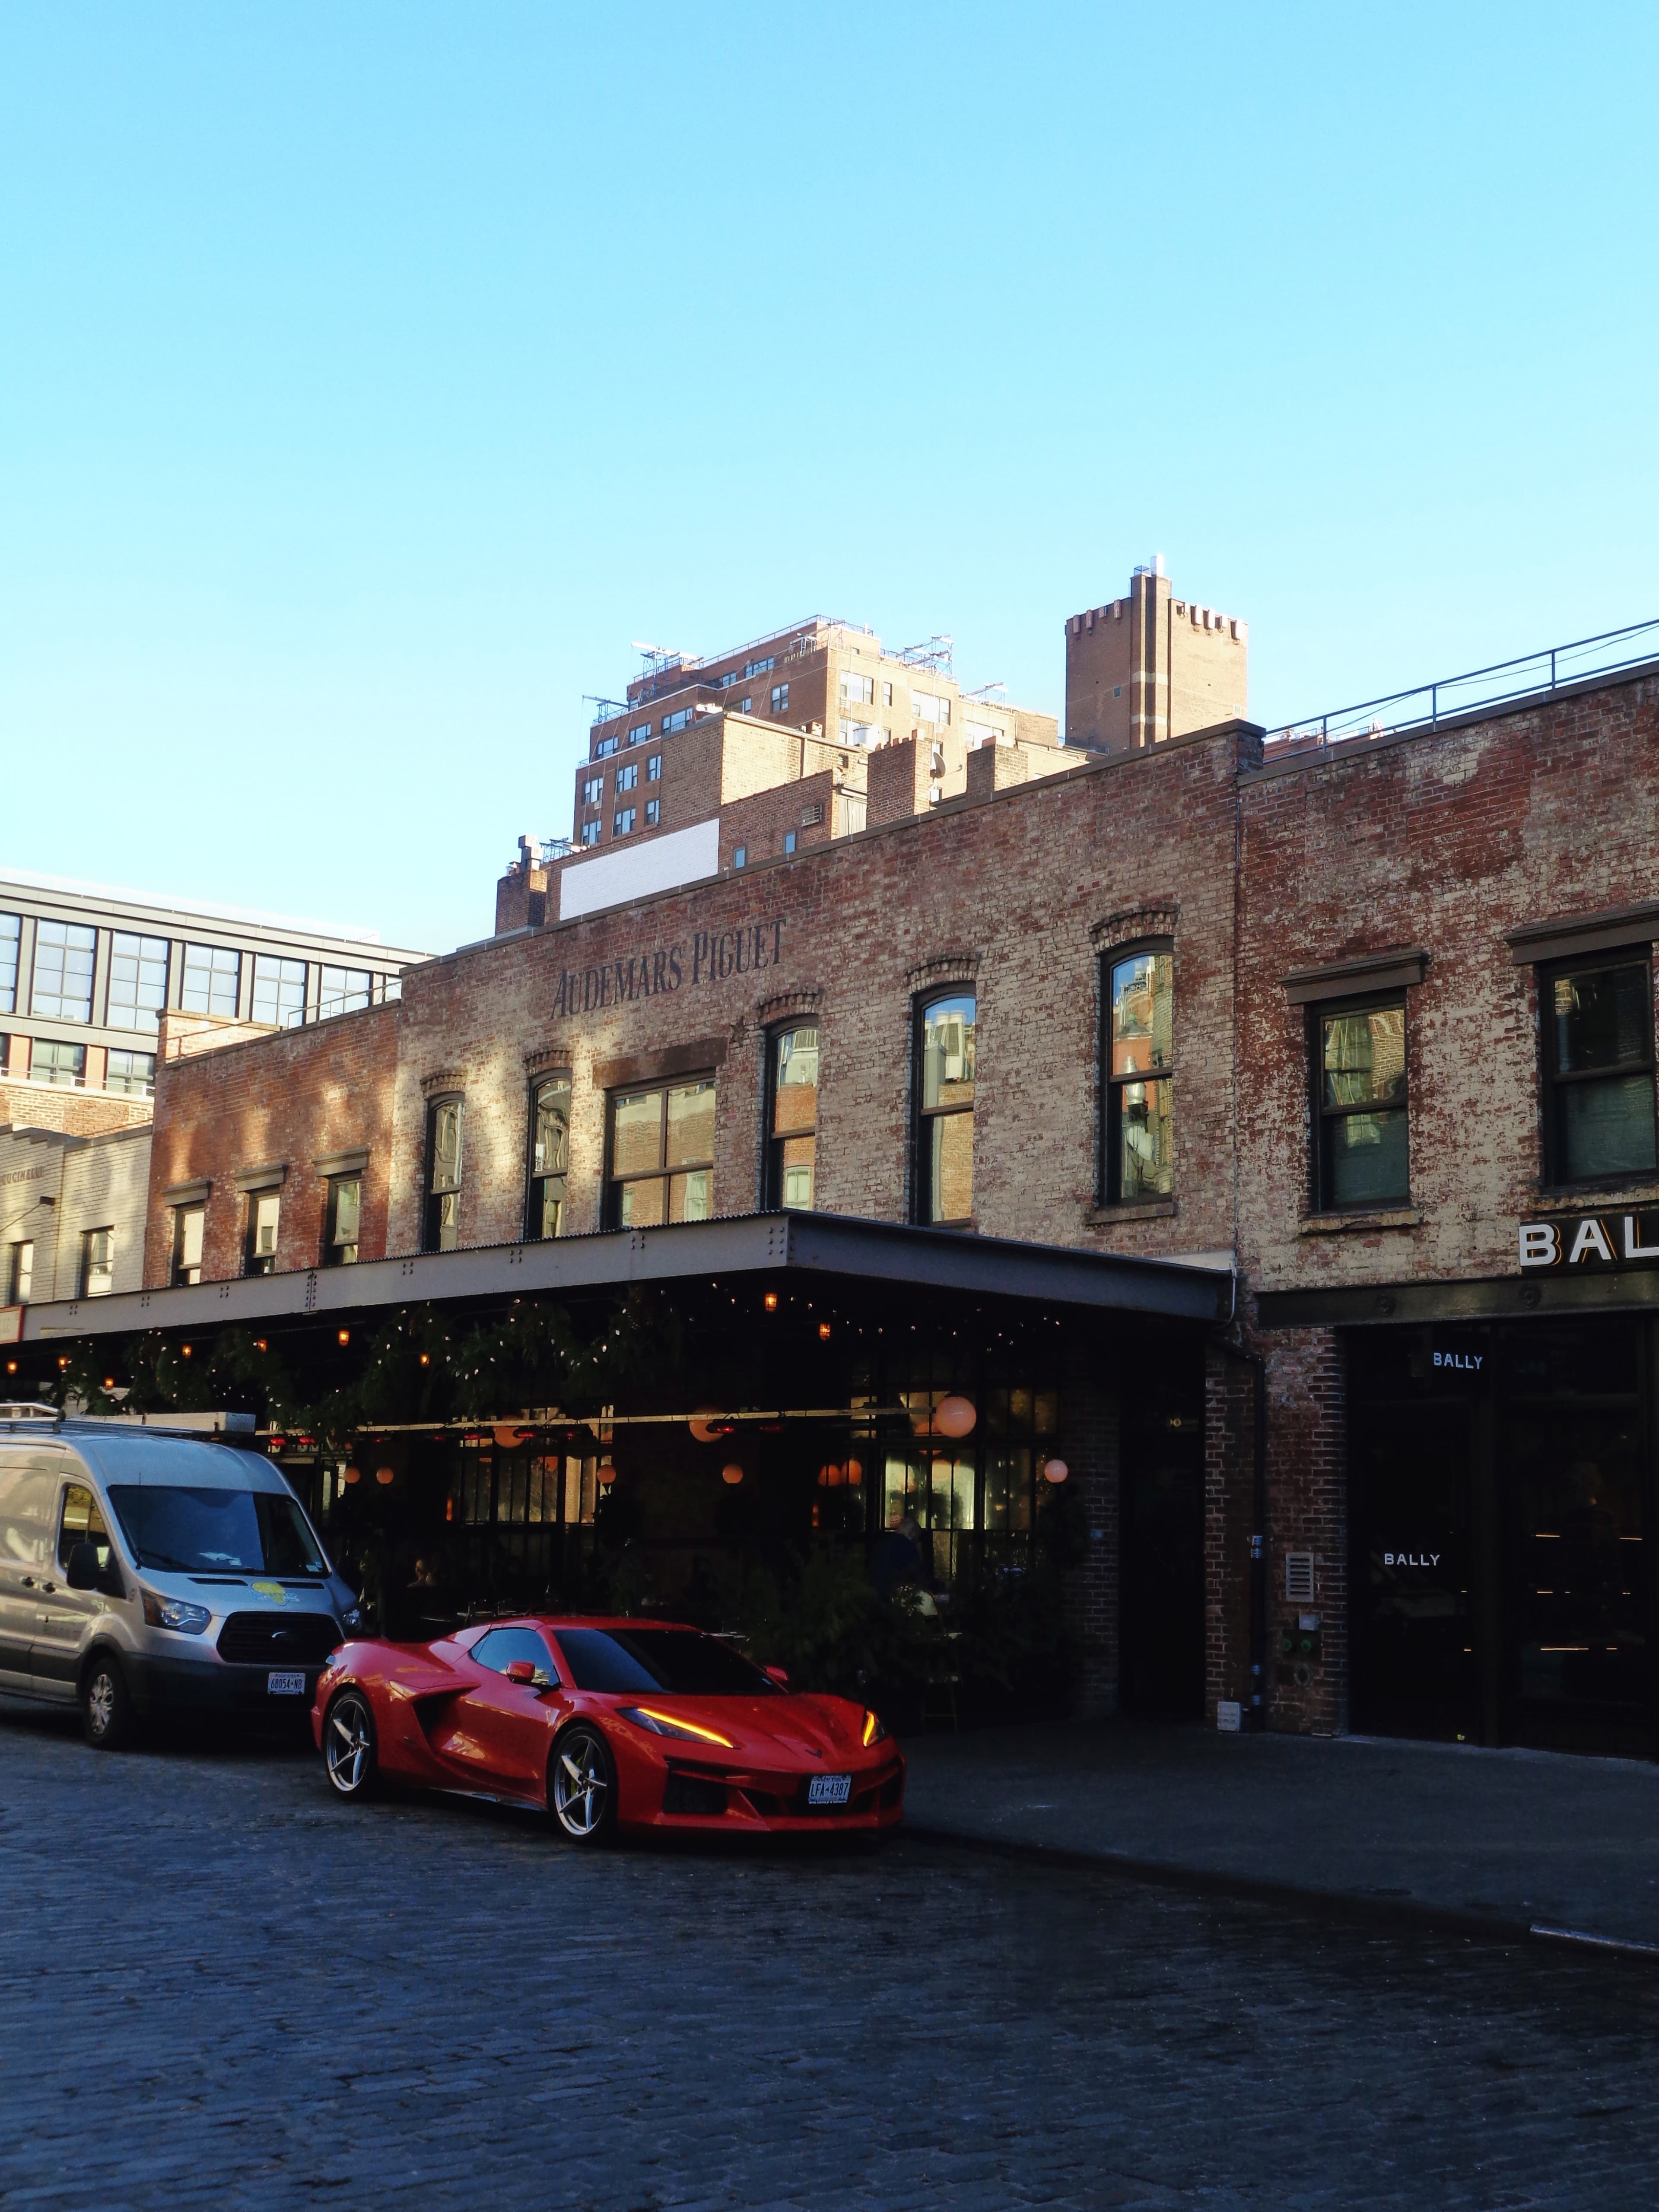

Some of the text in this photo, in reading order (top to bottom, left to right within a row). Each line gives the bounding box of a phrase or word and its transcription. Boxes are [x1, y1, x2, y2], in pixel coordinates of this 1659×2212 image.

[550, 918, 787, 1020] AUDEMARS PIGUET
[1433, 1352, 1483, 1370] BALLY
[1384, 1553, 1440, 1566] BALLY
